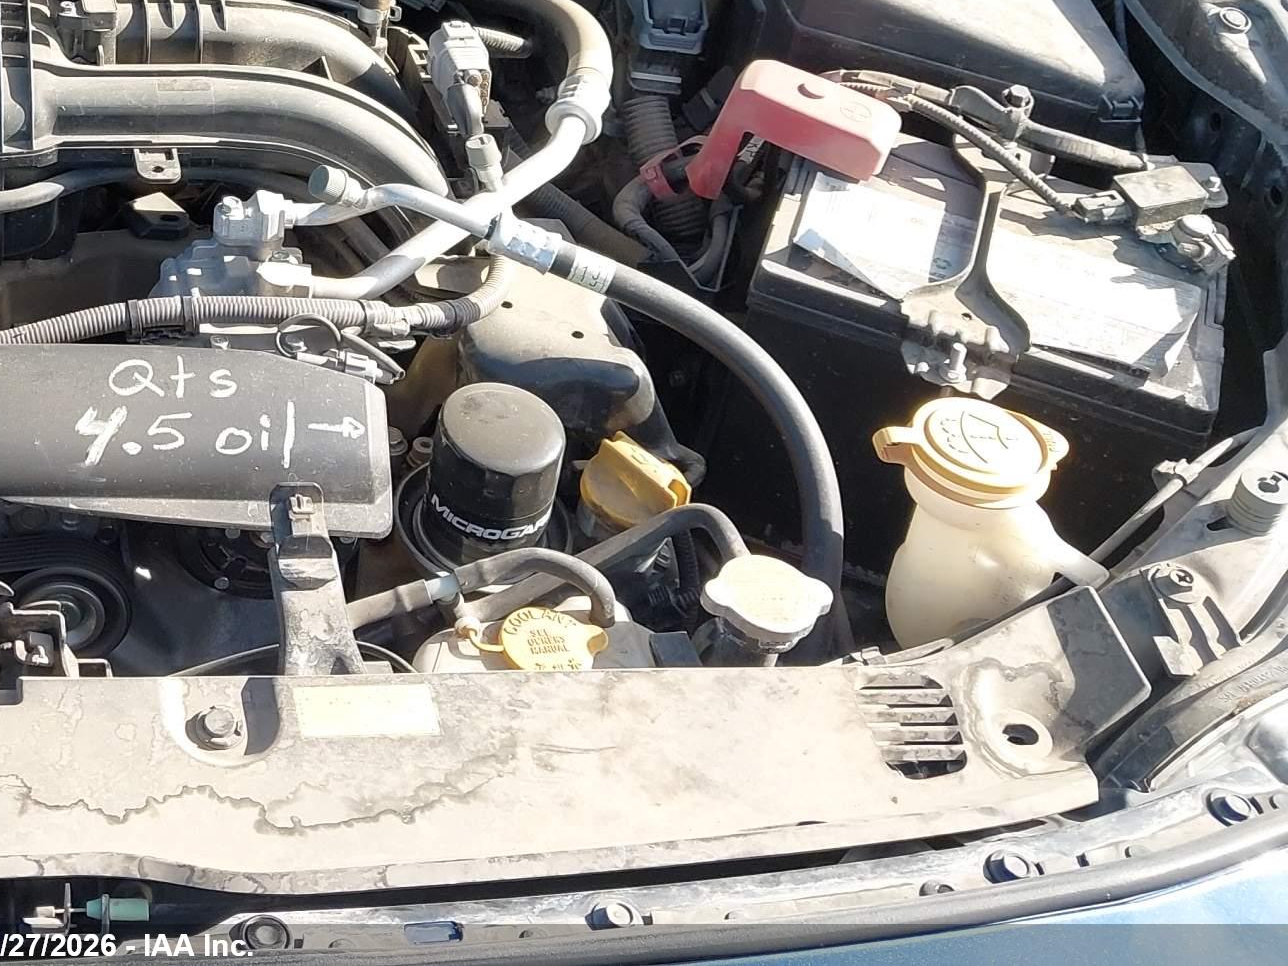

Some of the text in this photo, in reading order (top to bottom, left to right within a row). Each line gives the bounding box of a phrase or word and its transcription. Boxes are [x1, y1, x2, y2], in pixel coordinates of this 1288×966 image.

[109, 356, 238, 399] Qts
[75, 400, 295, 469] 4.5 oil
